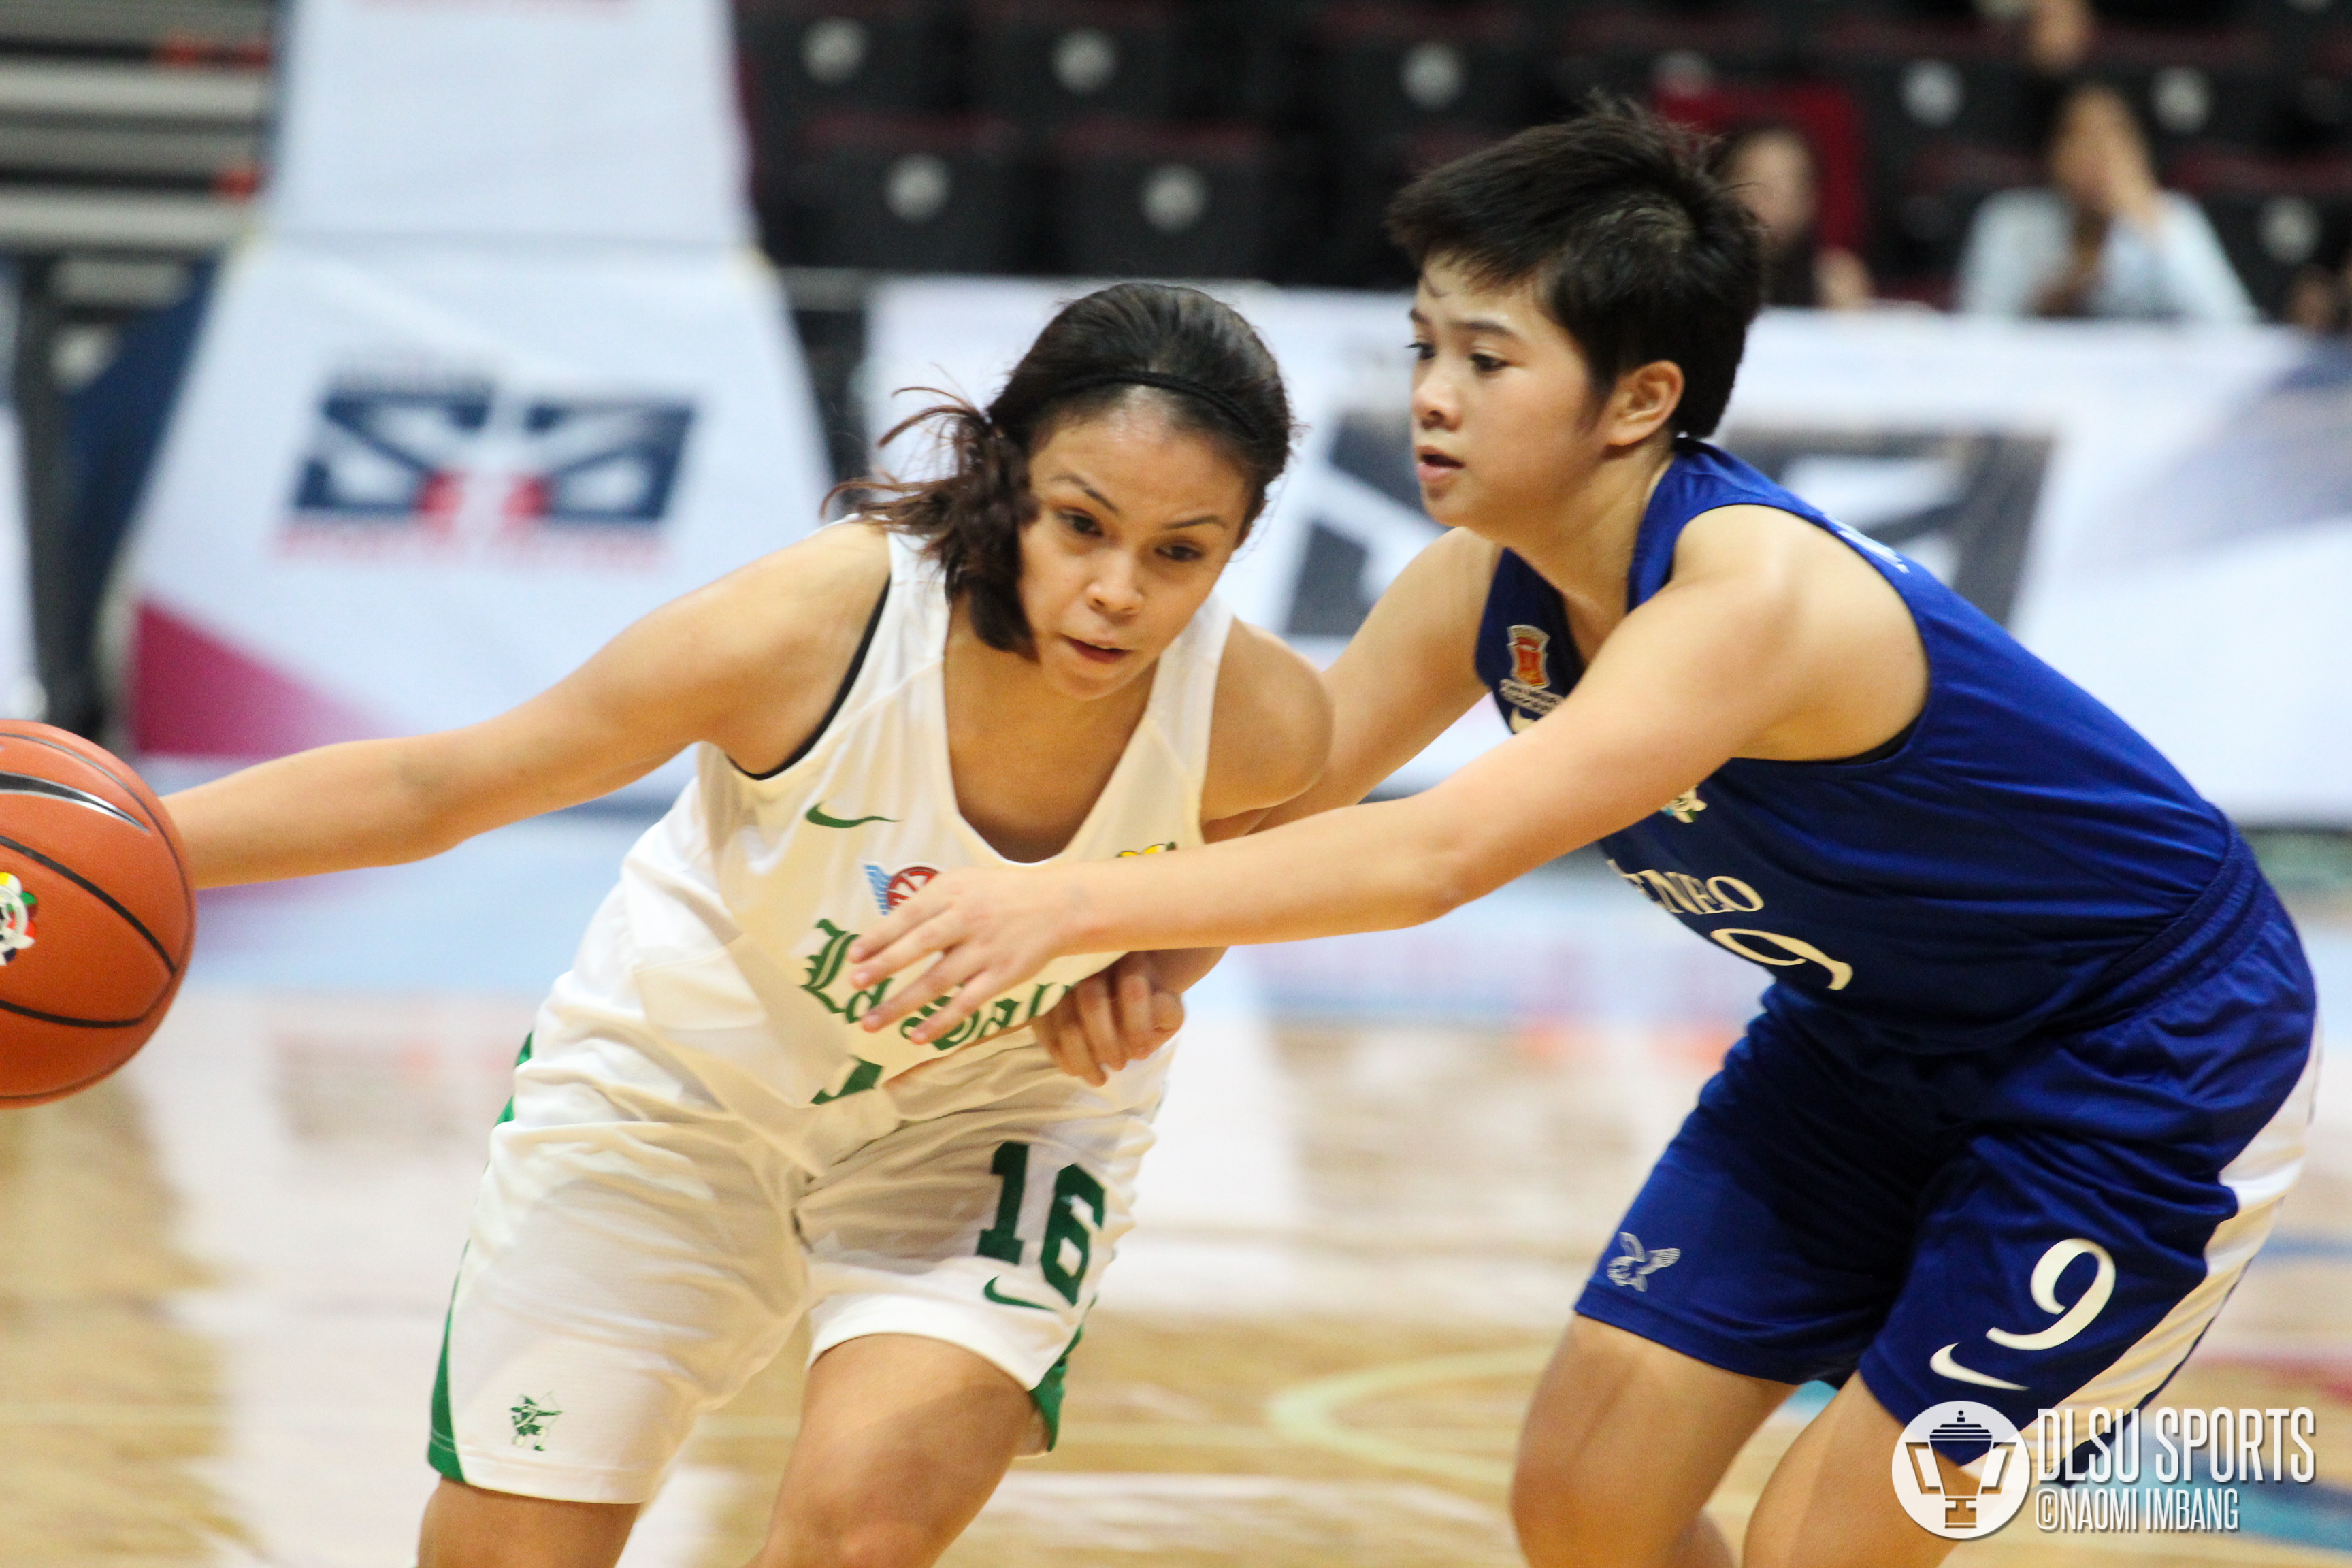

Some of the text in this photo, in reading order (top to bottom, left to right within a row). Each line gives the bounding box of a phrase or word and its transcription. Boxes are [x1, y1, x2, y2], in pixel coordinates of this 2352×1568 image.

[1710, 928, 1853, 991] 9
[975, 1141, 1106, 1308] 16
[1986, 1237, 2117, 1351] 9
